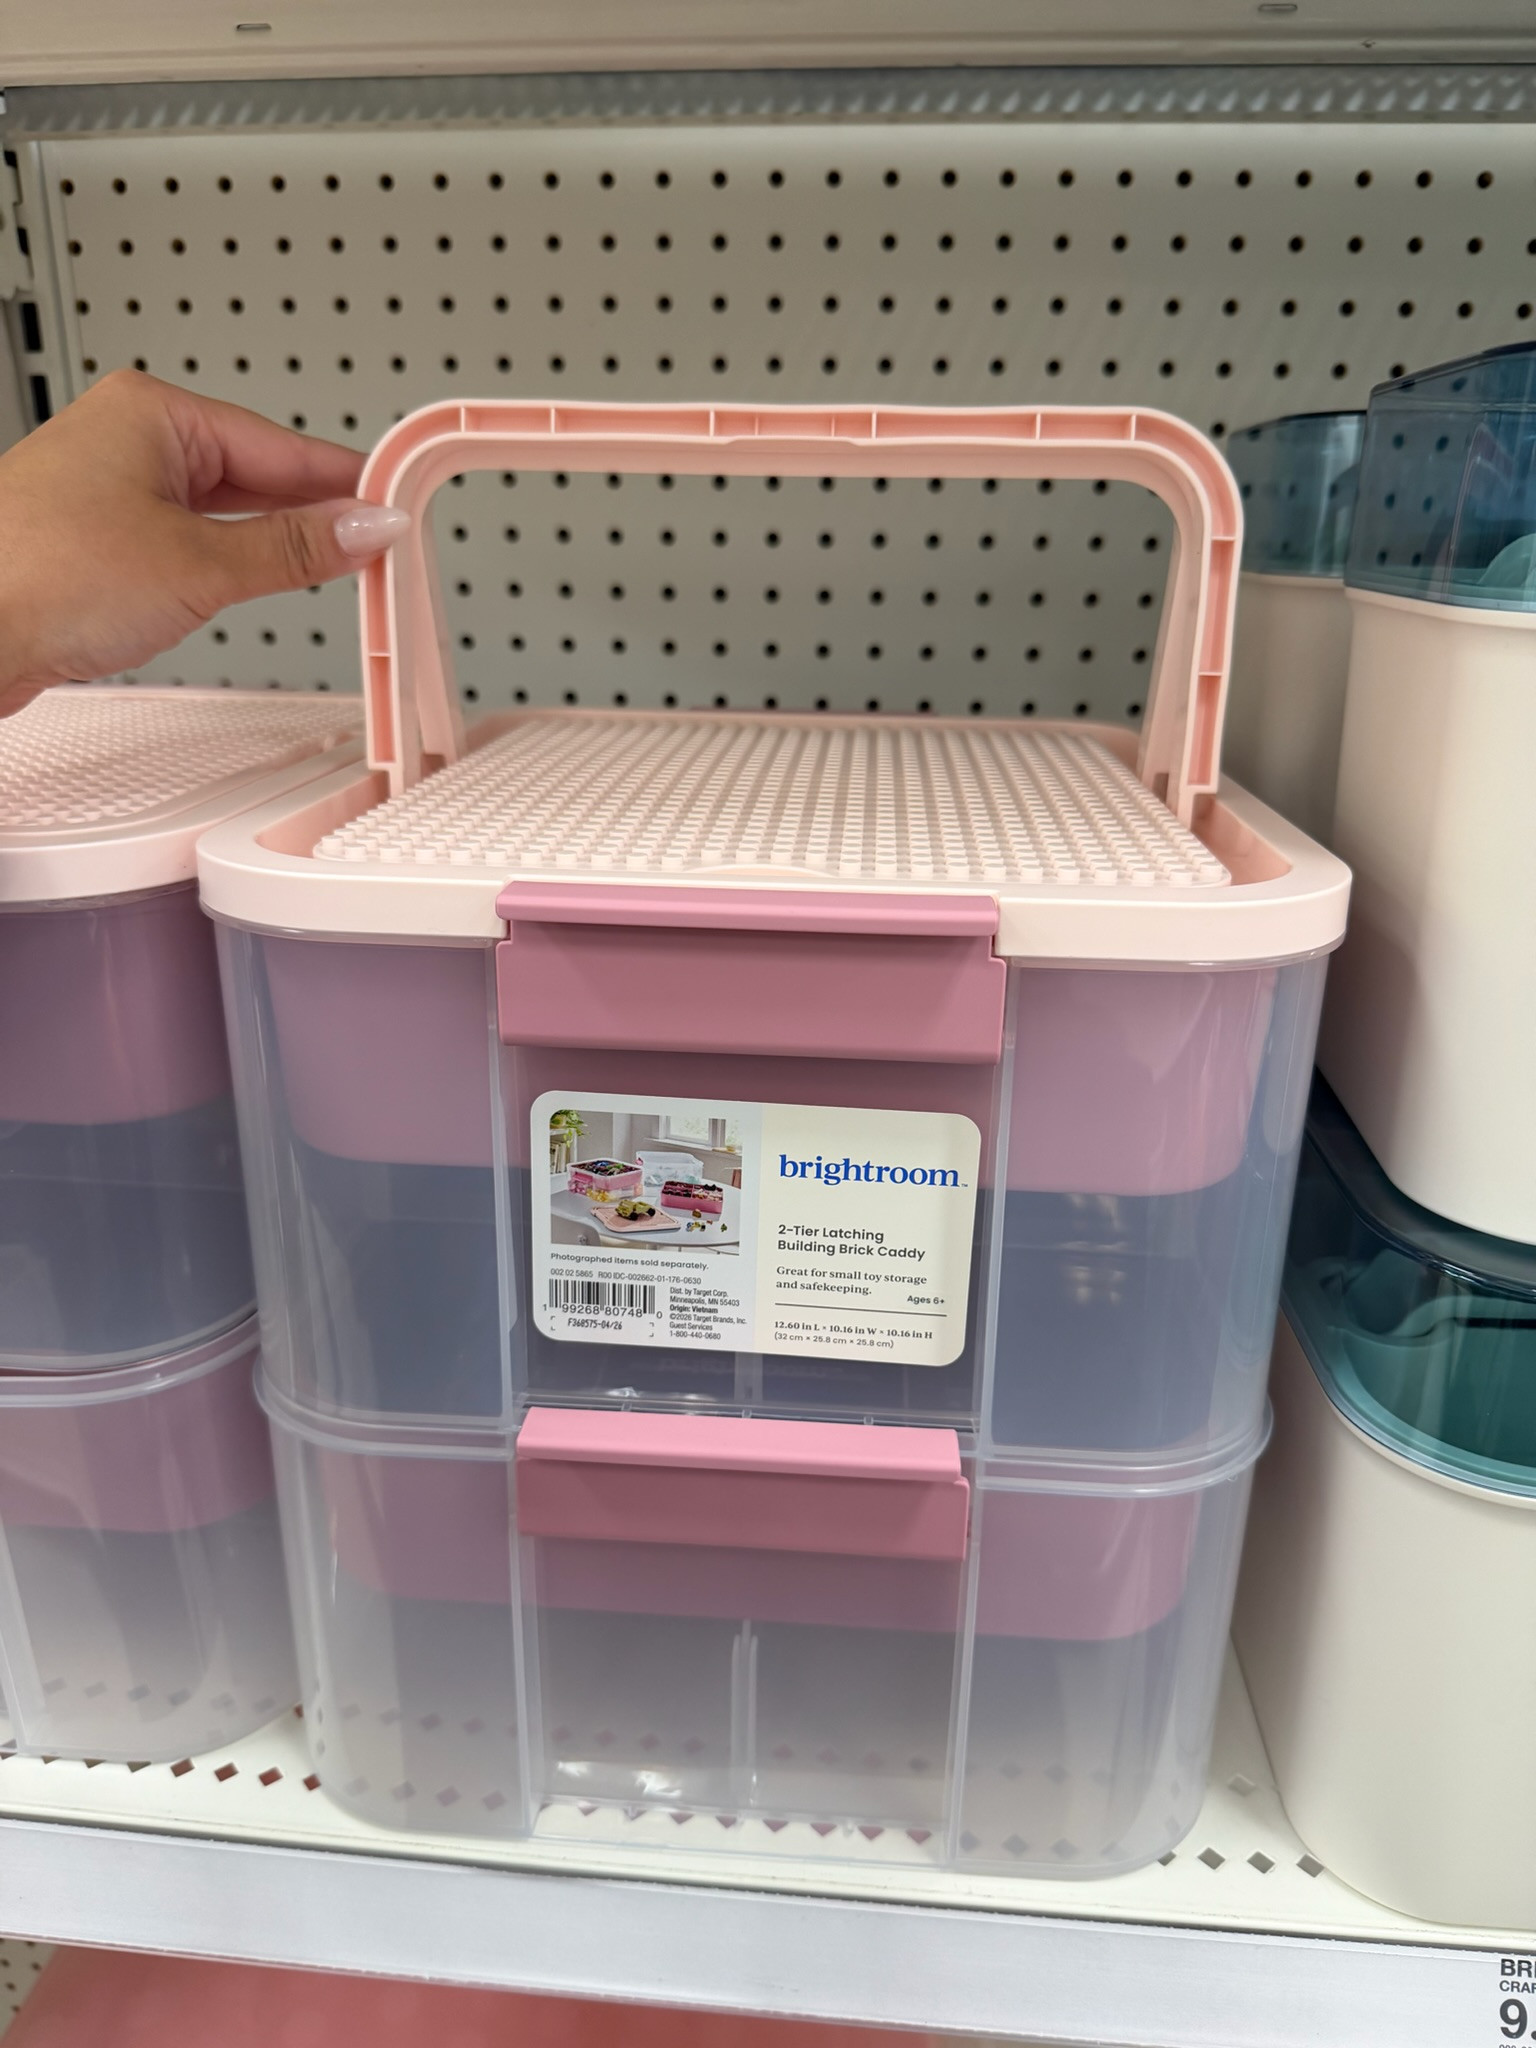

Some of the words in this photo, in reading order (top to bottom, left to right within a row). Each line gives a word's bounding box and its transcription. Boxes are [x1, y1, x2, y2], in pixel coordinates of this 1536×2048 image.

[778, 1225, 819, 1237] 2-Tier
[823, 1228, 884, 1243] Latching
[778, 1240, 835, 1256] Building
[840, 1244, 874, 1256] Brick
[878, 1246, 925, 1261] Caddy
[551, 1253, 612, 1263] Photographed
[615, 1257, 638, 1265] items
[661, 1262, 709, 1271] separately.
[776, 1266, 808, 1276] Great
[811, 1268, 828, 1277] for
[829, 1271, 861, 1280] small
[864, 1273, 882, 1283] toy
[884, 1275, 927, 1284] storage
[693, 1288, 712, 1297] Target
[776, 1281, 797, 1289] and
[800, 1282, 872, 1295] safekeeping.
[670, 1296, 706, 1305] Minneapolis,
[907, 1296, 931, 1305] Ages
[562, 1304, 600, 1315] 99268
[605, 1307, 642, 1317] 80748
[694, 1315, 712, 1323] Target
[775, 1321, 799, 1329] 12.60
[855, 1326, 865, 1334] in
[670, 1331, 721, 1339] 1-800-440-0680
[775, 1331, 787, 1340] (32
[813, 1335, 831, 1343] 25.8
[877, 1340, 894, 1348] cm)
